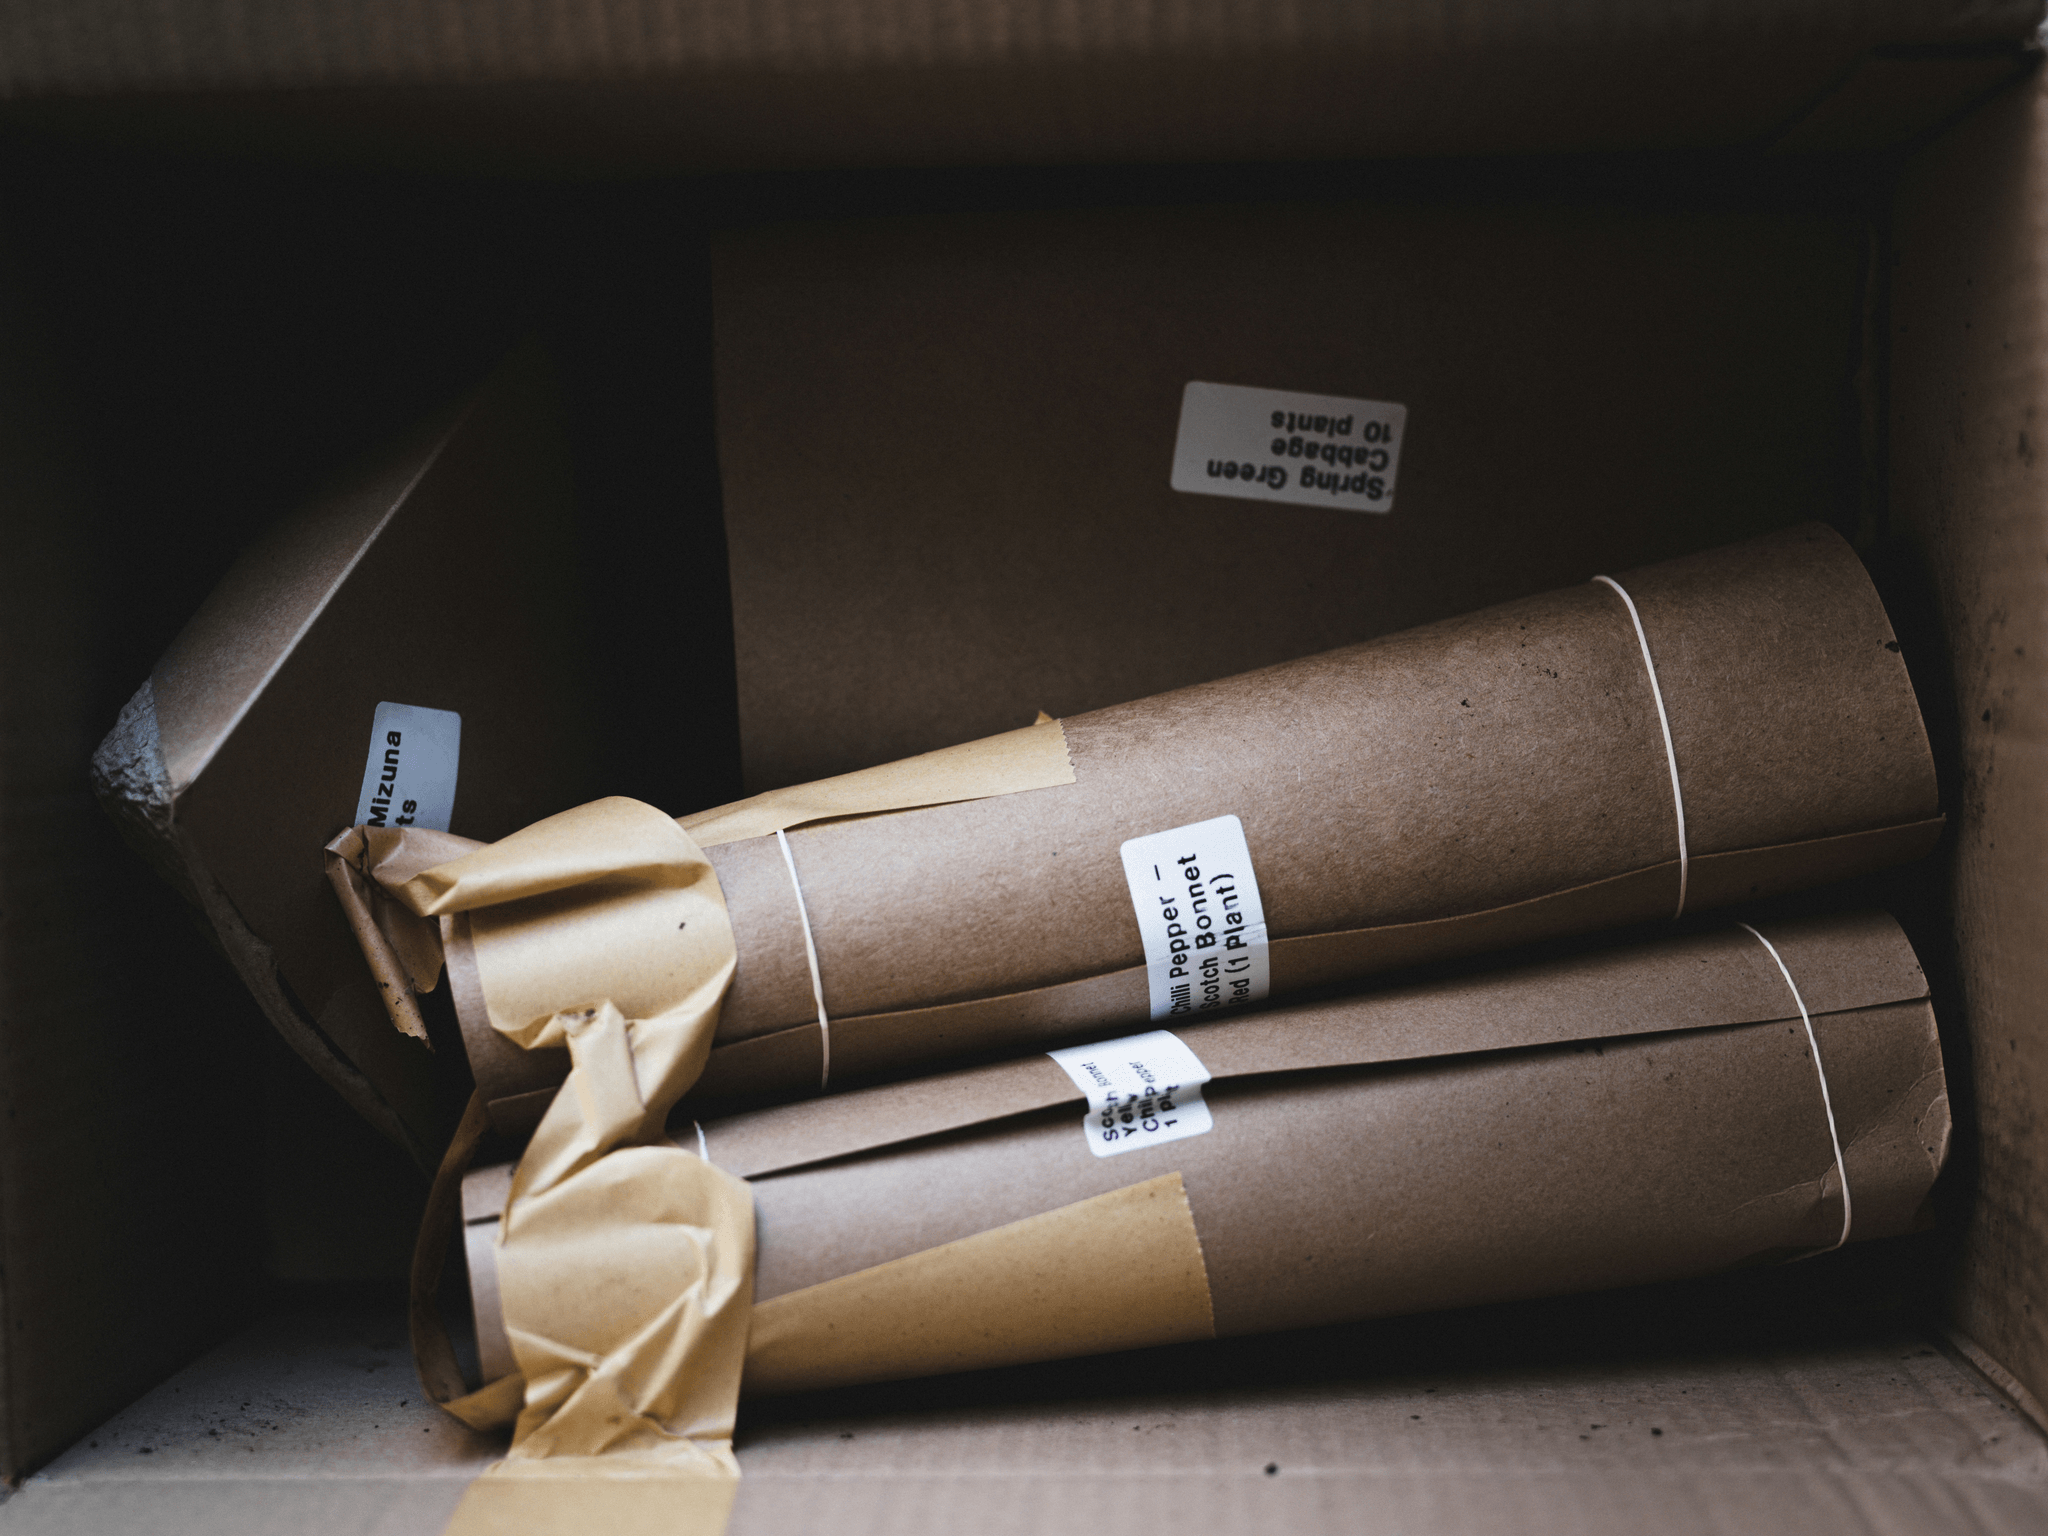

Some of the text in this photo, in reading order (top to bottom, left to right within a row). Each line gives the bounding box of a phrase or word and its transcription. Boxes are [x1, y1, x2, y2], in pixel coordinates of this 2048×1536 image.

[1270, 411, 1392, 444] 10 plants
[1270, 437, 1390, 472] Cabbage
[1206, 460, 1385, 501] Spring Green
[367, 731, 402, 828] Mizuna
[1159, 896, 1190, 978] Pepper
[1177, 853, 1220, 1010] Scotch Bonnet
[1209, 873, 1250, 1004] Red (1 Plant)
[1170, 983, 1191, 1015] Chilli
[1118, 1094, 1138, 1137] Yellw
[1165, 1119, 1177, 1127] 1
